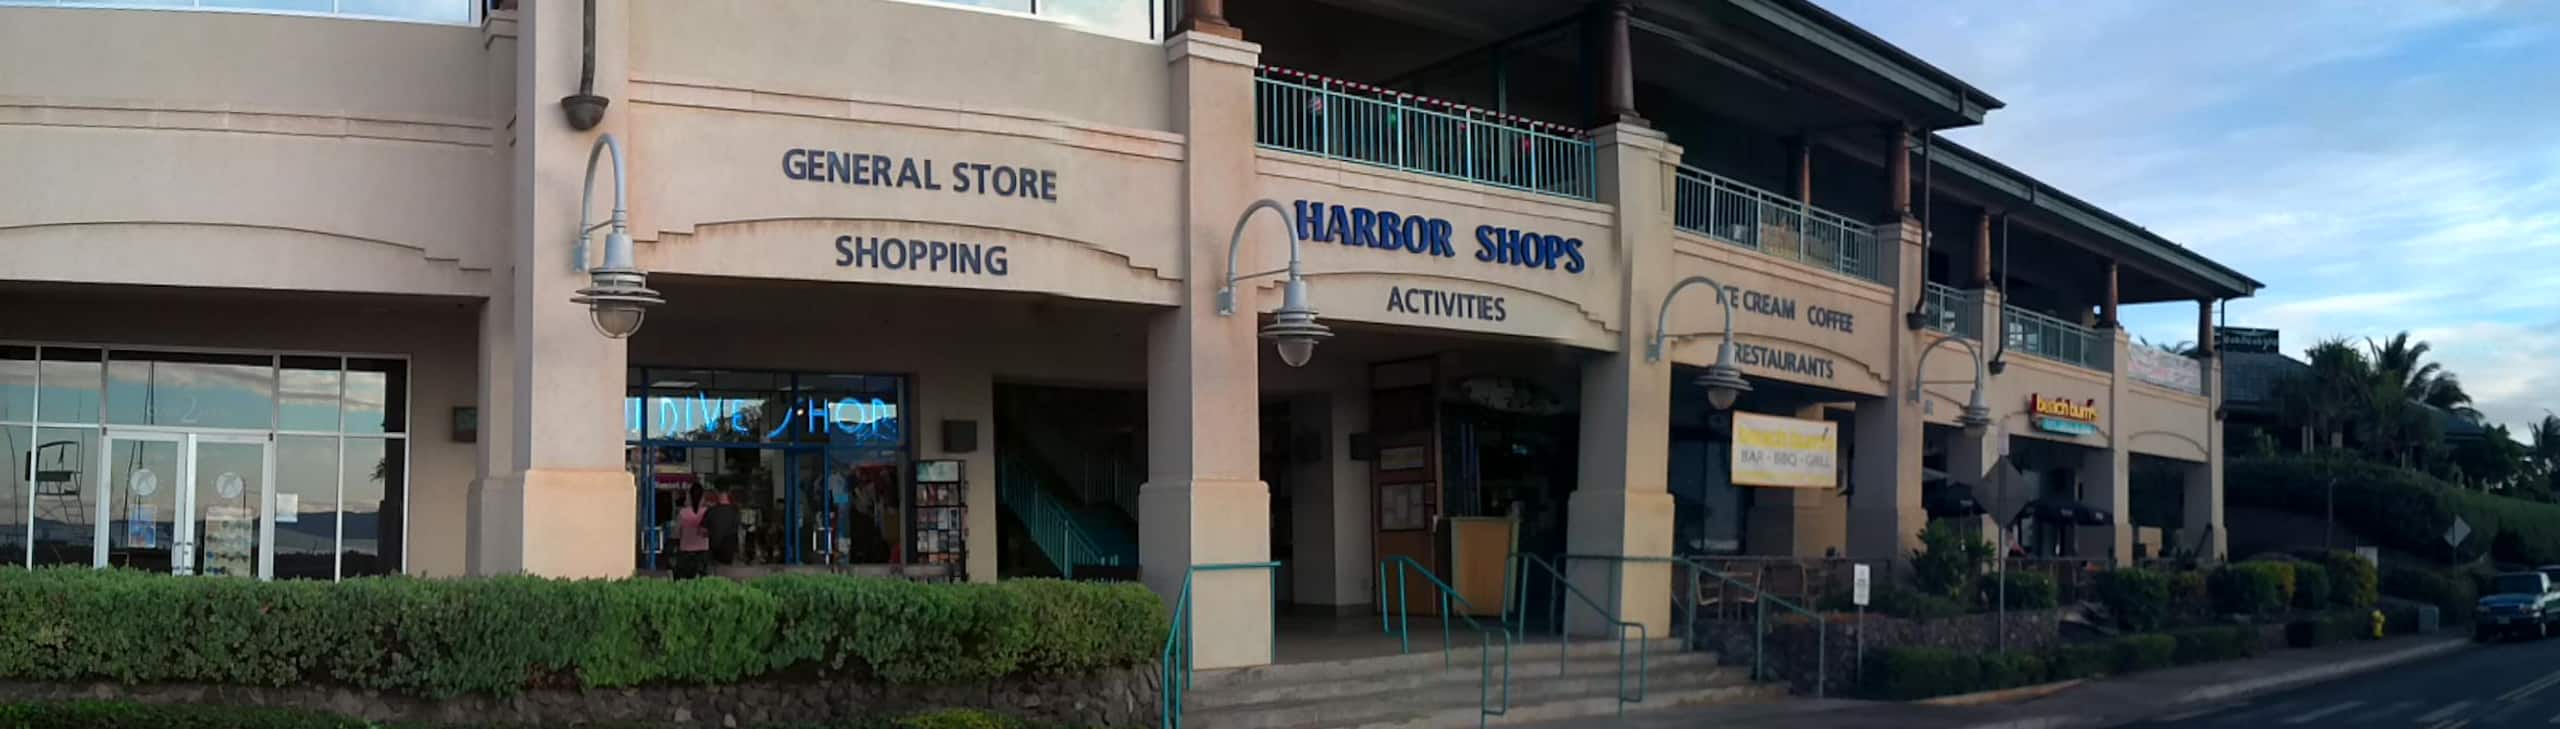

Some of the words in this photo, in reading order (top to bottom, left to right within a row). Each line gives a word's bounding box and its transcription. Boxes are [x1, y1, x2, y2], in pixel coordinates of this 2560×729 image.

[782, 148, 942, 191] GENERAL
[951, 162, 1058, 202] STORE
[834, 235, 1009, 276] SHOPPING
[1294, 199, 1455, 258] HARBOR
[1474, 224, 1586, 274] SHOPS
[1386, 286, 1507, 321] ACTIVITIES
[1743, 290, 1796, 321] CREAM
[1807, 305, 1854, 334] COFFEE
[1734, 342, 1834, 380] RESTAURANTS
[659, 391, 751, 437] DIVE
